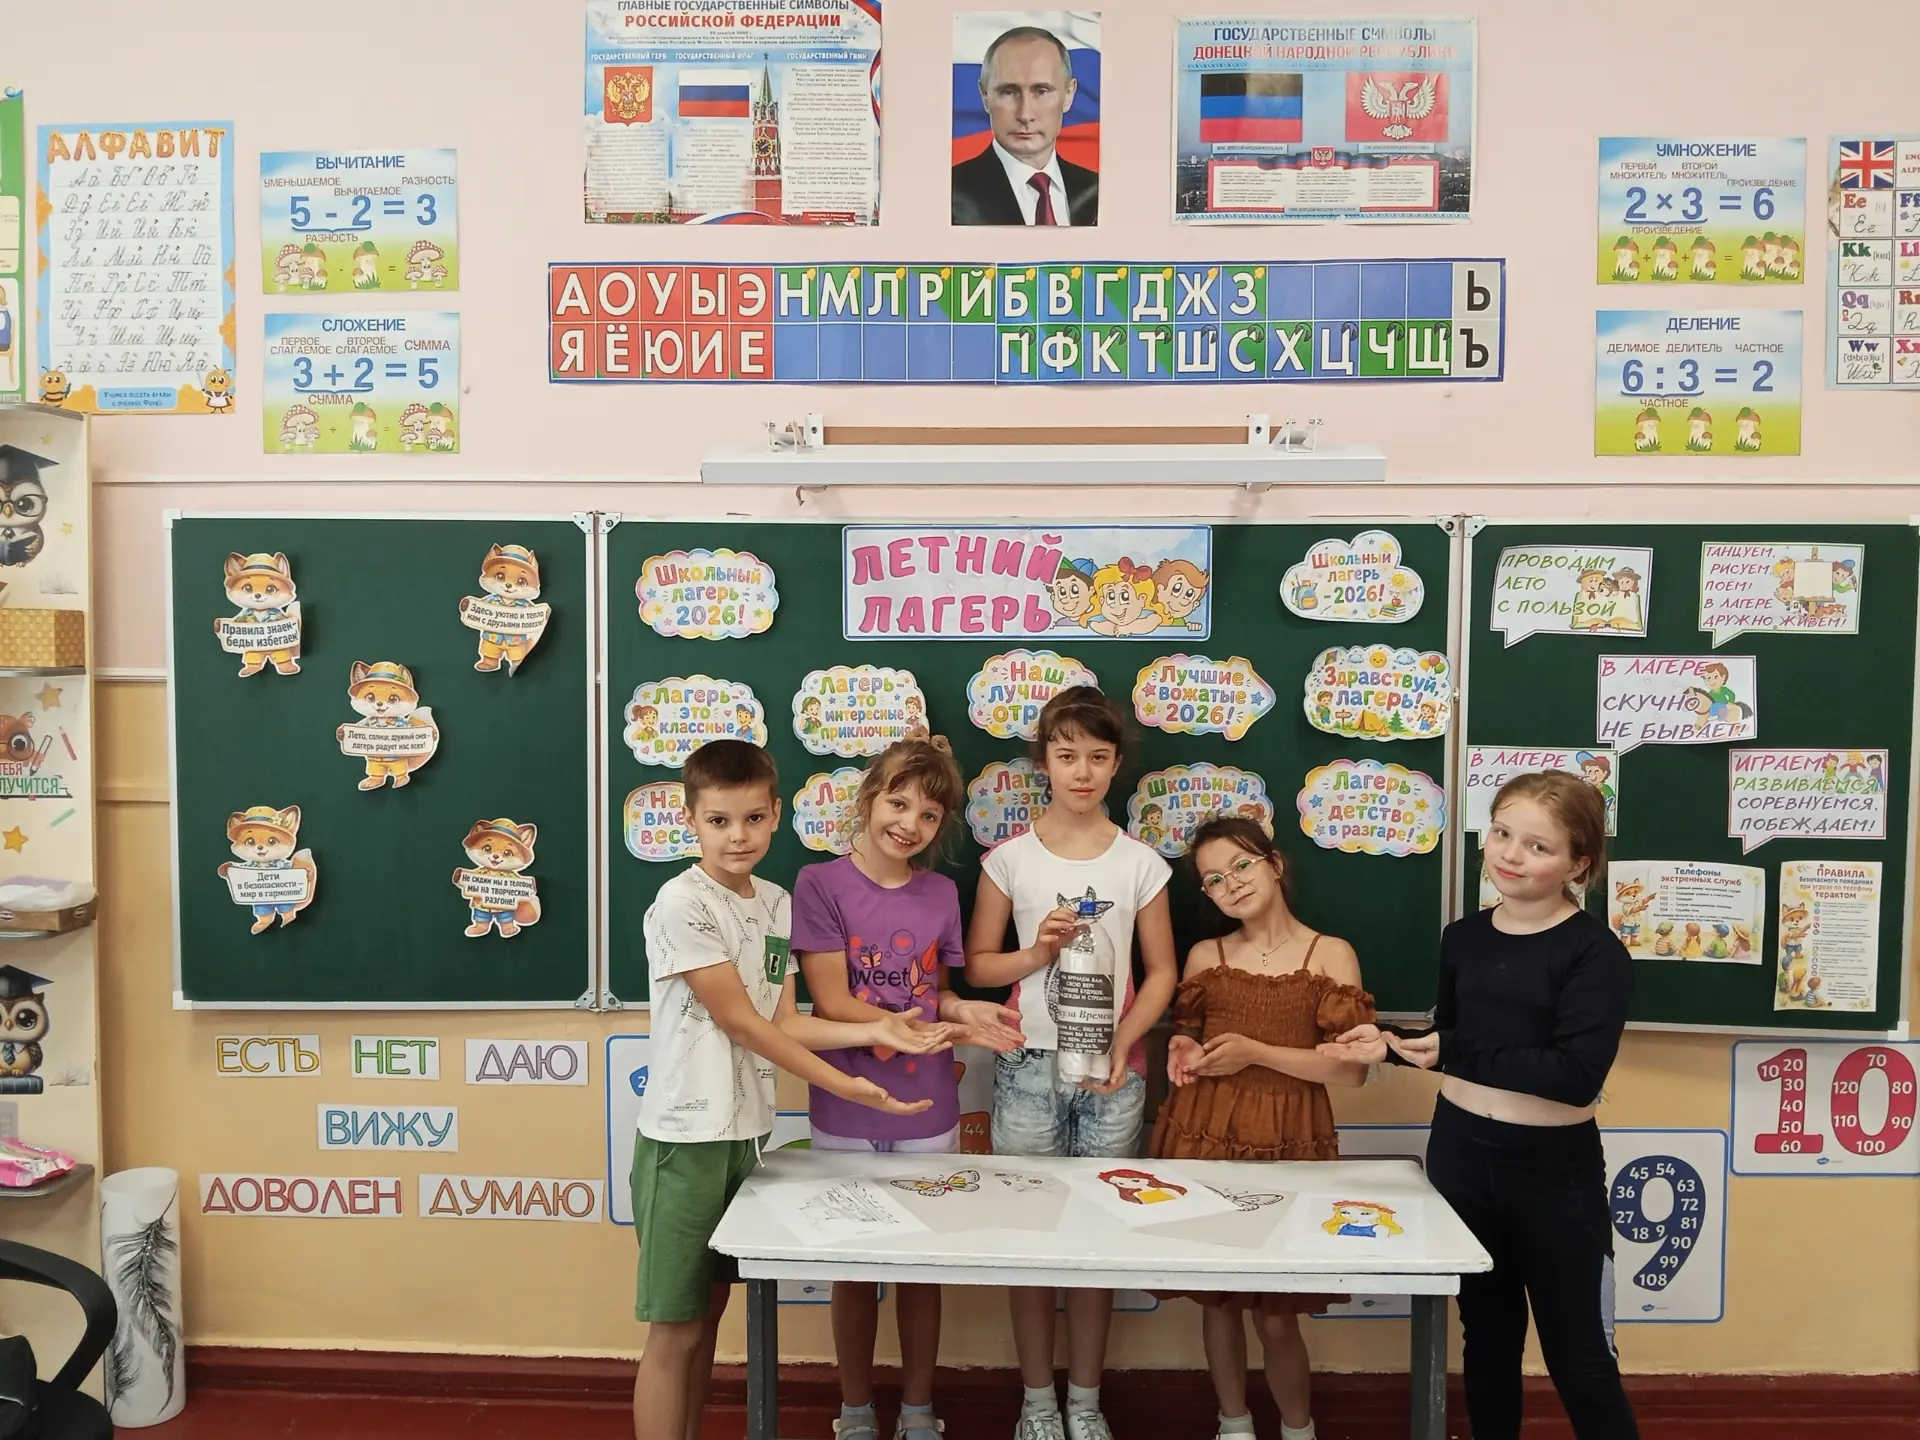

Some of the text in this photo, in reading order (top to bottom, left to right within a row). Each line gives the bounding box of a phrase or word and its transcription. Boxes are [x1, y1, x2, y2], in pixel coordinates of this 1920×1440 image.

[618, 0, 849, 11] ГЛАВНЫЕ ГОСУДАРСТВЕННЫЕ СИМВОЛЫ
[625, 12, 841, 29] РОССИЙСКОЙ ФЕДЕРАЦИИ
[1214, 28, 1357, 42] ГОСУДАРСТВЕННЫЕ
[591, 52, 650, 61] ГОСУДАРСТВЕННЫЙ
[675, 52, 736, 60] ГОСУДАРСТВЕННЫЙ
[787, 52, 848, 60] ГОСУДАРСТВЕННЫЙ
[1193, 44, 1272, 61] ДОНЕЦКОЙ
[46, 128, 228, 163] АЛФАВИТ
[1656, 143, 1757, 157] УМНОЖЕНИЕ
[315, 155, 405, 170] ВЫЧИТАНИЕ
[1621, 162, 1657, 170] ПЕРВЫЙ
[1682, 162, 1718, 170] ВТОРОЙ
[402, 176, 455, 185] РАЗНОСТЬ
[1610, 171, 1667, 179] МНОЖИТЕЛЬ
[1672, 171, 1728, 179] МНОЖИТЕЛЬ
[264, 177, 341, 188] УМЕНЬШАЕМОЕ
[1727, 178, 1796, 188] ПРОИЗВЕДЕНИЕ
[334, 186, 402, 196] ВЫЧИТАЕМОЕ
[1626, 187, 1775, 220] 2 3 6
[1844, 194, 1867, 208] Ee
[290, 194, 437, 227] 5 2 3
[1632, 226, 1703, 235] ПРОИЗВЕДЕНИЕ
[305, 233, 359, 243] РАЗНОСТЬ
[1842, 243, 1871, 257] Kk
[555, 271, 767, 316] А О У Ы Э
[1842, 291, 1869, 309] Qq
[322, 318, 406, 332] СЛОЖЕНИЕ
[1666, 317, 1740, 332] ДЕЛЕНИЕ
[281, 337, 320, 346] ПЕРВОЕ
[346, 336, 386, 345] ВТОРОЕ
[404, 340, 450, 351] СУММА
[1848, 340, 1879, 352] Ww
[270, 345, 332, 355] СЛАГАЕМОЕ
[336, 345, 397, 354] СЛАГАЕМОЕ
[1607, 343, 1784, 354] ДЕЛИМОЕ ДЕЛИТЕЛЬ ЧАСТНОЕ
[308, 394, 354, 405] СУММА
[1640, 398, 1688, 408] ЧАСТНОЕ
[852, 533, 1063, 586] ЛЕТНИЙ
[1311, 553, 1391, 569] Школьный
[1502, 554, 1616, 571] ПРОВОДИМ
[655, 564, 761, 586] Школьный
[1328, 569, 1380, 583] лагерь
[1498, 576, 1546, 590] ЛЕТО
[671, 586, 739, 604] лагерь
[1334, 584, 1384, 604] 2026!
[1498, 600, 1616, 616] С ПОЛЬЗОЙ
[1704, 598, 1772, 609] В ЛАГЕРЕ
[471, 604, 493, 616] Здесь
[495, 610, 518, 619] уютно
[677, 605, 745, 625] 2026!
[858, 594, 1051, 634] ЛАГЕРЬ
[487, 620, 520, 628] друзьями
[1703, 615, 1848, 628] ДРУЖНО ЖИВЕМ!
[222, 623, 264, 635] Правила
[226, 632, 298, 648] беды избегаем!
[1010, 661, 1064, 684] Наш
[1601, 659, 1709, 676] В ЛАГЕРЕ
[1160, 666, 1244, 686] Лучшие
[1324, 666, 1439, 697] Здравствуй,
[847, 694, 876, 707] это
[1159, 687, 1246, 704] вожатые
[1336, 690, 1423, 711] лагерь!
[1603, 693, 1700, 712] СКУЧНО
[680, 707, 711, 719] это
[825, 709, 904, 723] интересные
[1166, 703, 1234, 725] 2026!
[660, 722, 734, 734] классные
[1602, 721, 1746, 740] НЕ БЫВАЕТ!
[352, 743, 374, 751] лагерь
[1333, 771, 1411, 794] Лагерь
[1360, 793, 1389, 805] это
[1328, 805, 1415, 825] детство
[1740, 817, 1876, 833] ПОБЕЖДАЕМ!
[1329, 825, 1415, 843] в разгаре!
[257, 873, 280, 882] Дети
[1674, 867, 1721, 876] Телефоны
[1817, 869, 1865, 878] ПРАВИЛА
[244, 881, 297, 890] безопасности
[462, 874, 470, 882] Не
[472, 876, 491, 884] сидим
[1661, 876, 1741, 886] экстренных служб
[265, 888, 302, 898] гармонии!
[492, 888, 530, 896] творческом
[1815, 891, 1856, 899] терактом
[485, 897, 515, 905] разгоне!
[216, 1038, 320, 1072] ЕСТЬ
[355, 1040, 436, 1074] НЕТ
[1867, 1054, 1887, 1067] 70
[476, 1044, 578, 1081] ДАЮ
[1783, 1059, 1803, 1072] 20
[1833, 1082, 1858, 1094] 120
[325, 1110, 453, 1147] ВИЖУ
[1856, 1140, 1886, 1152] 100
[1656, 1163, 1675, 1175] 54
[202, 1177, 402, 1215] ДОВОЛЕН
[429, 1178, 595, 1217] ДУМАЮ
[1639, 1274, 1667, 1286] 108
